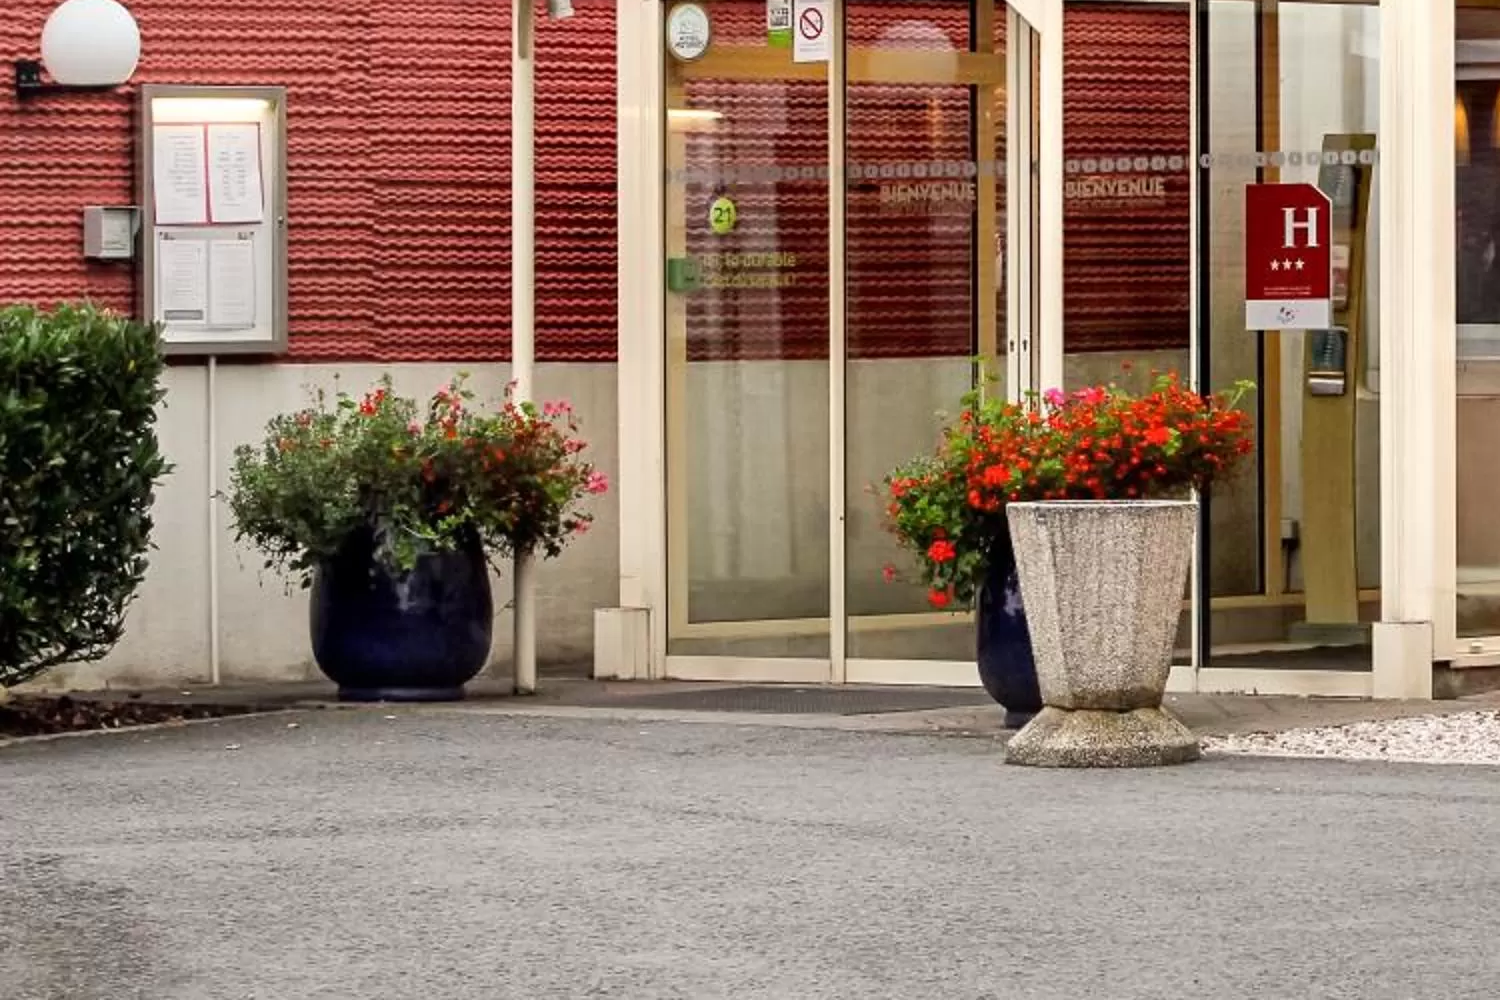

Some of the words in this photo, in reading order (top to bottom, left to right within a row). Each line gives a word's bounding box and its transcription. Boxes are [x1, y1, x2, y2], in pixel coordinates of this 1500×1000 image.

[880, 182, 977, 203] BIENVENUE
[1064, 176, 1166, 199] BIENVENUE
[713, 206, 732, 224] 21
[1280, 206, 1321, 249] H
